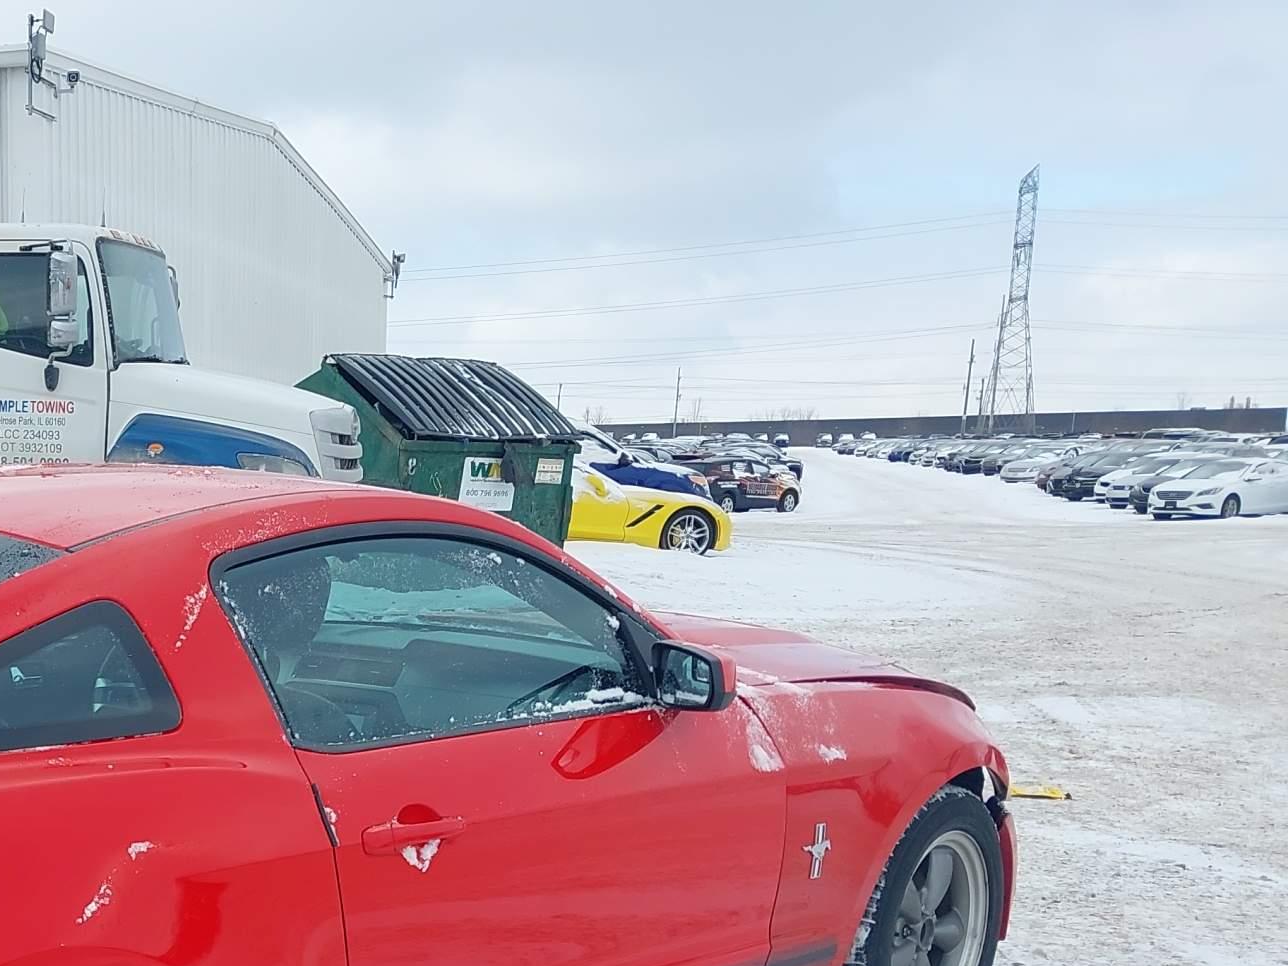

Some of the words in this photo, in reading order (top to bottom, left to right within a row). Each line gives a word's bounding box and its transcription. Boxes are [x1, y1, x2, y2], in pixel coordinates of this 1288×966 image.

[30, 401, 75, 414] TOWING
[18, 417, 35, 426] Park,
[37, 417, 43, 426] IL
[45, 417, 66, 426] 60160
[23, 430, 60, 440] 234093
[19, 443, 62, 453] 3932109
